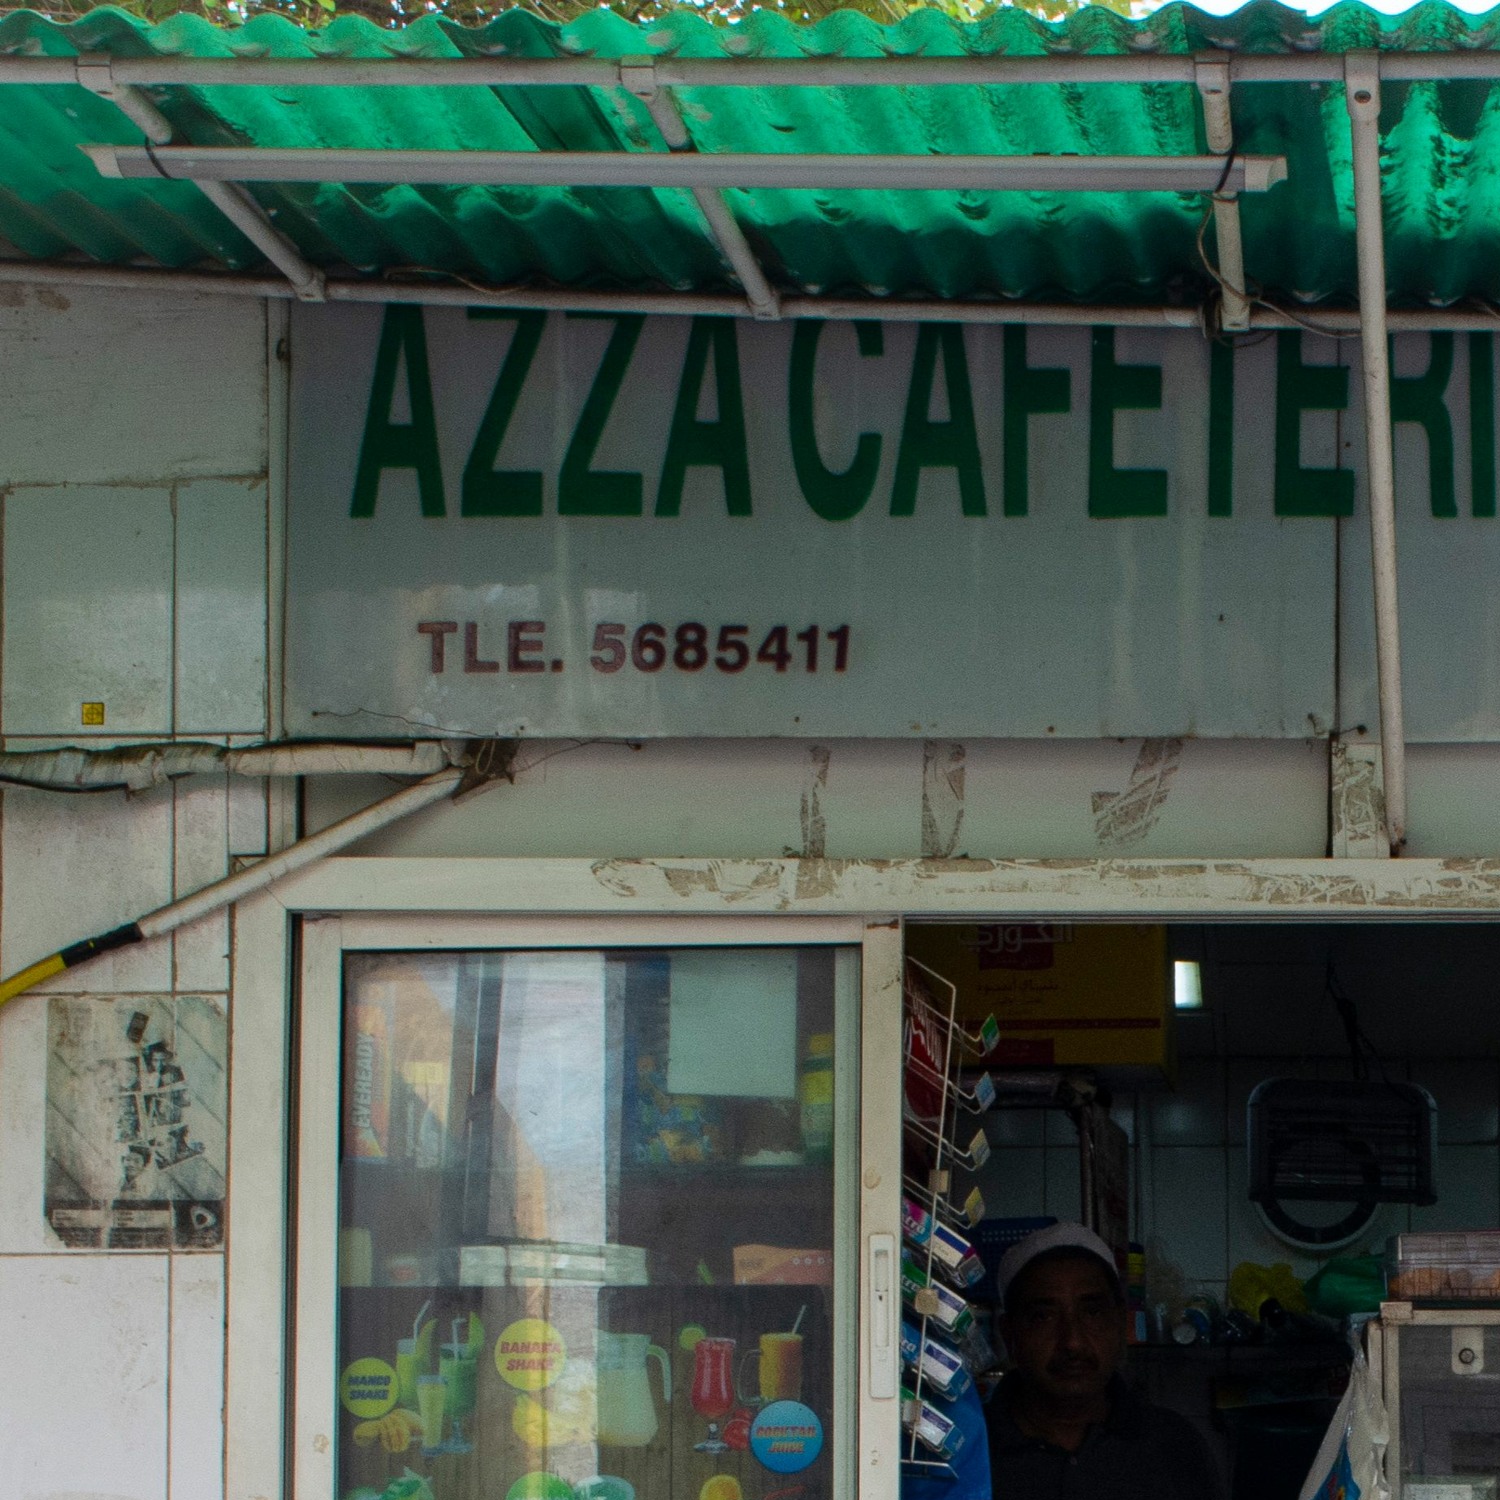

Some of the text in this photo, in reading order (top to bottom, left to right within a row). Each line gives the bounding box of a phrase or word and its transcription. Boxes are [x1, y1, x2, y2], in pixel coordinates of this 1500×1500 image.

[350, 303, 755, 519] AZZA
[418, 621, 852, 674] TLE. 5685411
[500, 1341, 561, 1353] BANANA
[507, 1358, 555, 1371] SHAKE
[349, 1389, 389, 1401] SHAKE
